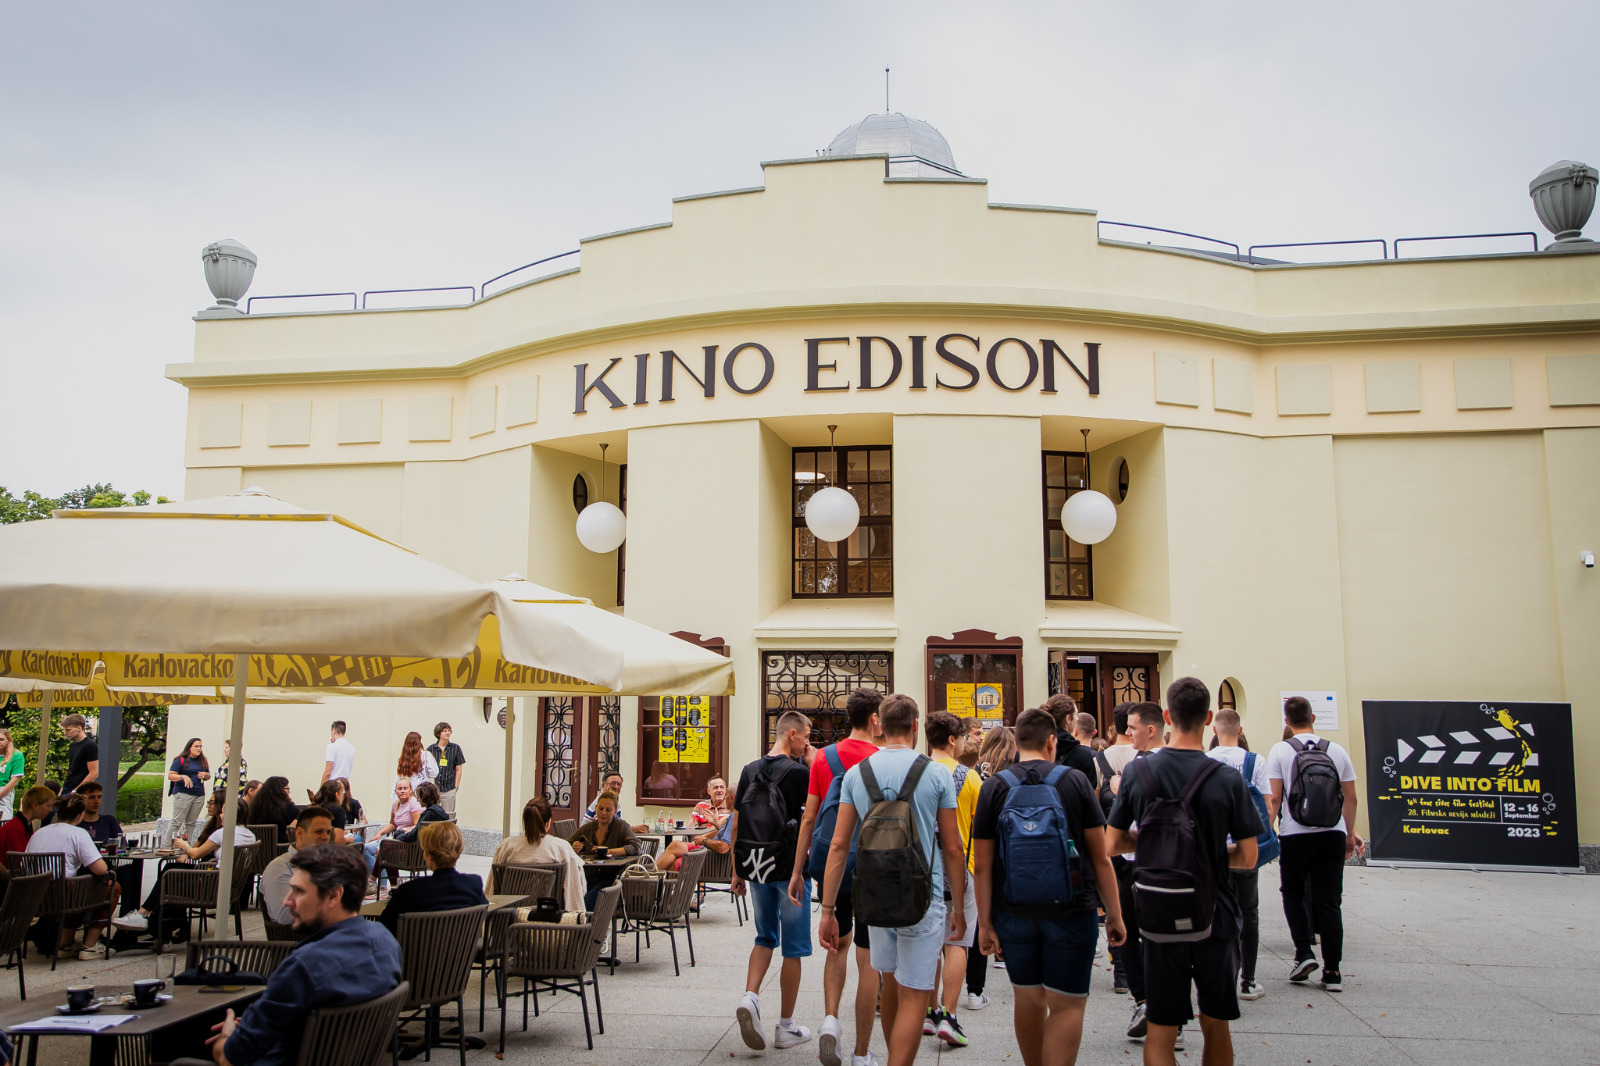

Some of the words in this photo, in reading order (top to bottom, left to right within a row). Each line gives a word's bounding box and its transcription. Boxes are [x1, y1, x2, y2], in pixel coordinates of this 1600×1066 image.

[573, 342, 775, 414] KINO
[803, 333, 1102, 396] EDISON
[123, 653, 234, 678] Karlovačko
[1400, 775, 1442, 790] DIVE
[1446, 777, 1492, 791] INTO
[1497, 778, 1541, 793] FILM
[1468, 799, 1495, 808] festival
[1503, 802, 1516, 812] 12
[1526, 803, 1539, 813] 16
[1403, 825, 1450, 835] Karlovac
[1507, 827, 1541, 838] 2023
